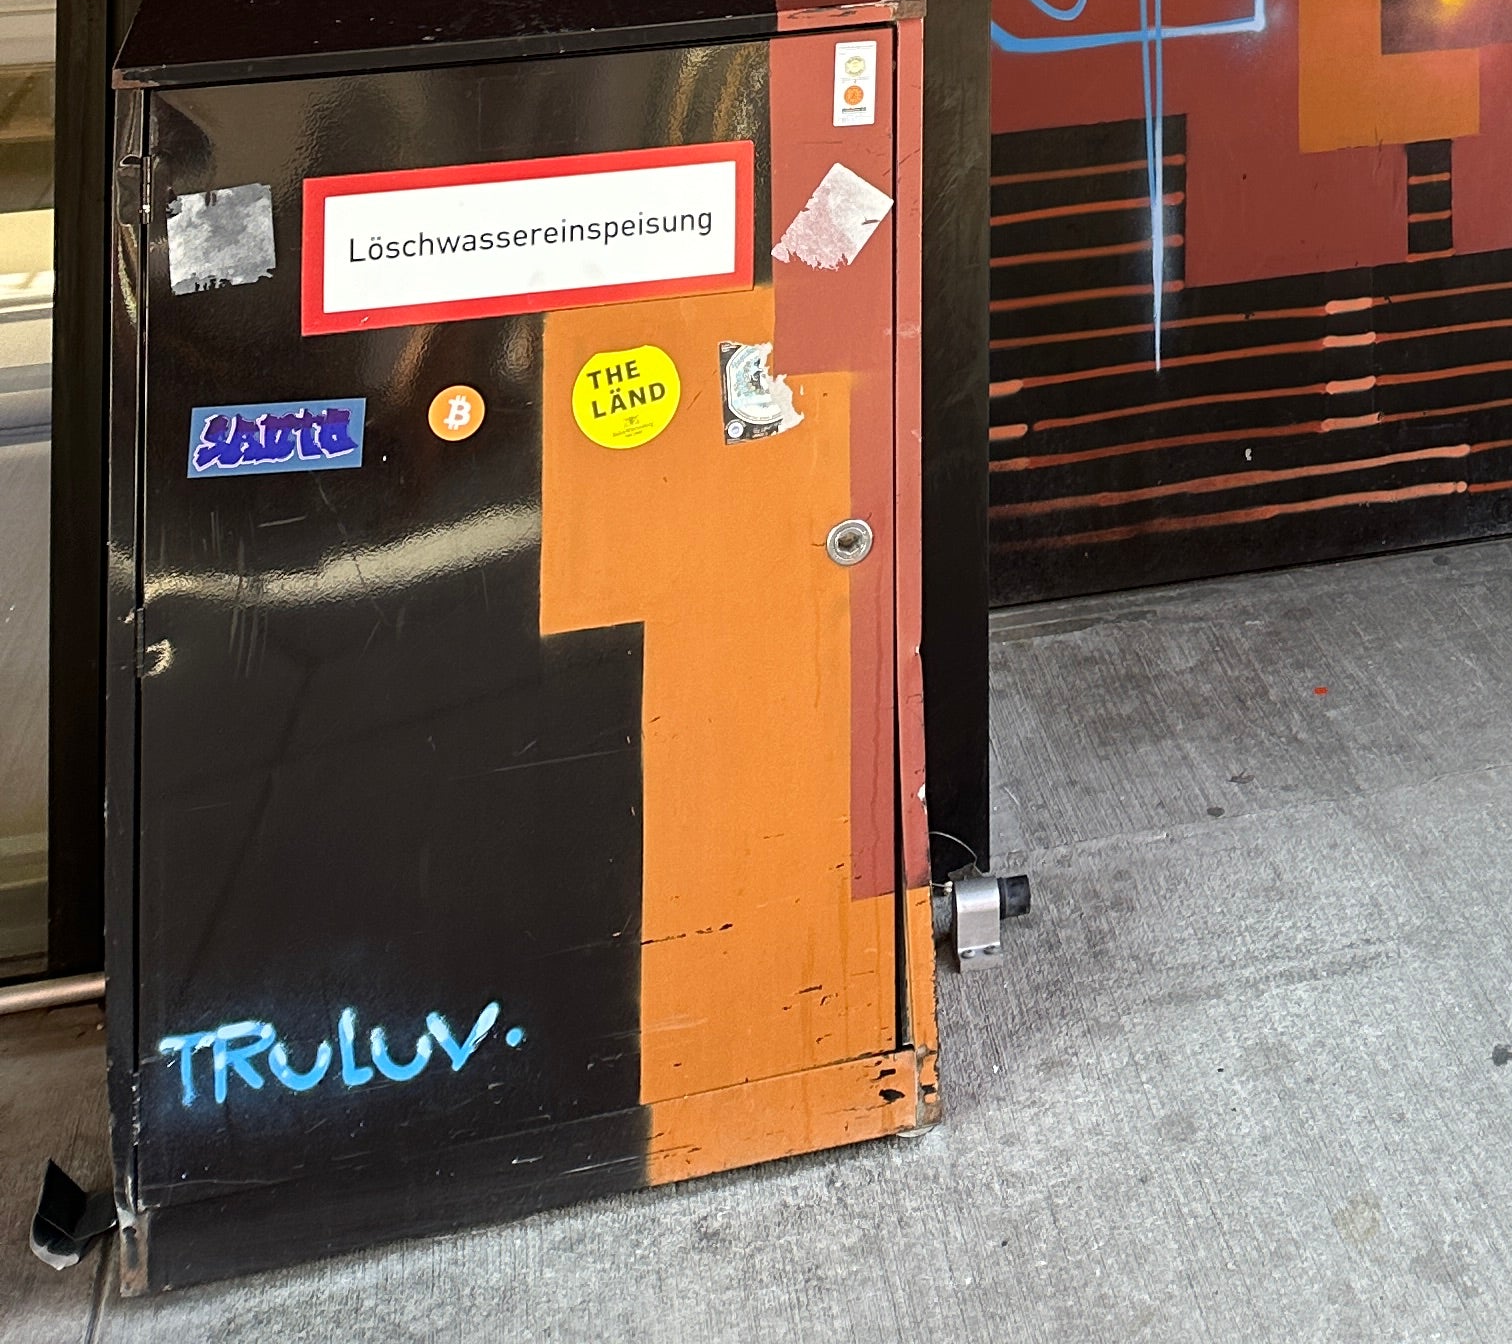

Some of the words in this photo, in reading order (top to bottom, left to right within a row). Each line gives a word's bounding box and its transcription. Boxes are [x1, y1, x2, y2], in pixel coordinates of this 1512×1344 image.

[349, 211, 712, 263] Löschwassereinspeisung
[586, 359, 641, 390] THE
[591, 381, 667, 420] LÄND
